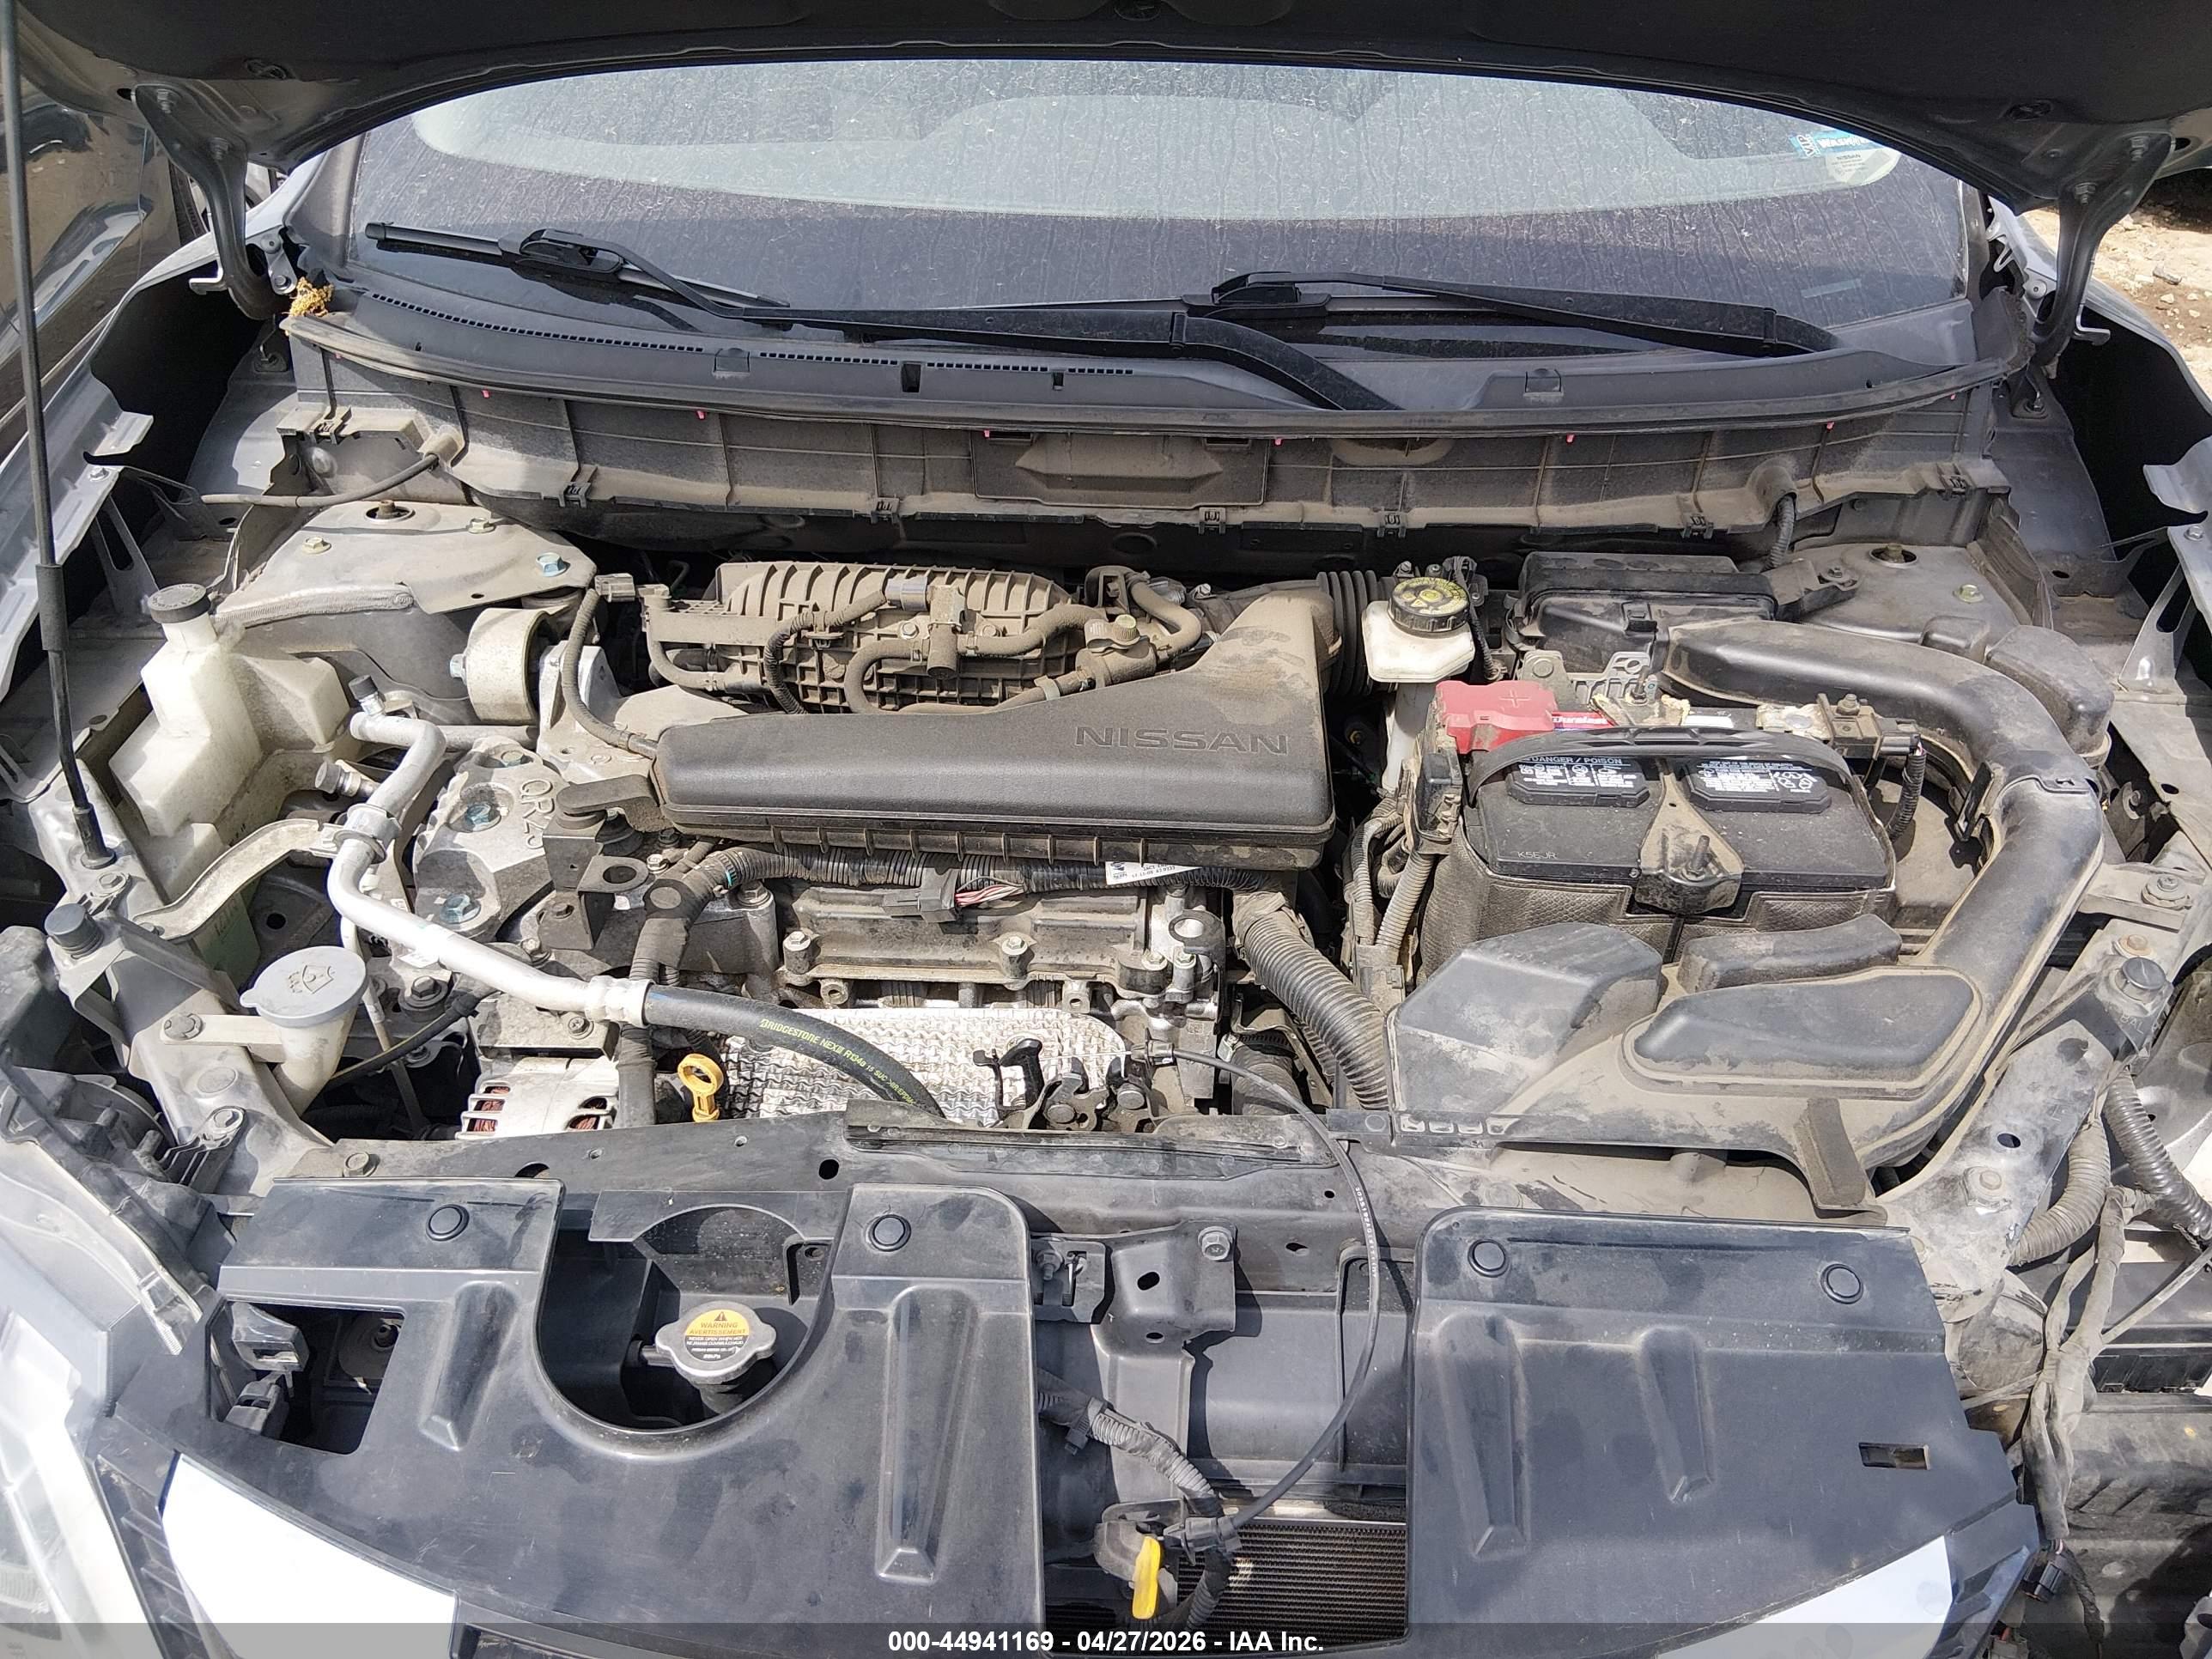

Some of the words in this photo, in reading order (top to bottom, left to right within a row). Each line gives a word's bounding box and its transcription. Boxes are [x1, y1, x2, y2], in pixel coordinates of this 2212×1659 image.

[1797, 134, 1814, 156] VIP
[1074, 726, 1288, 756] NISSAN
[759, 1018, 820, 1044] BRIDGESTONE
